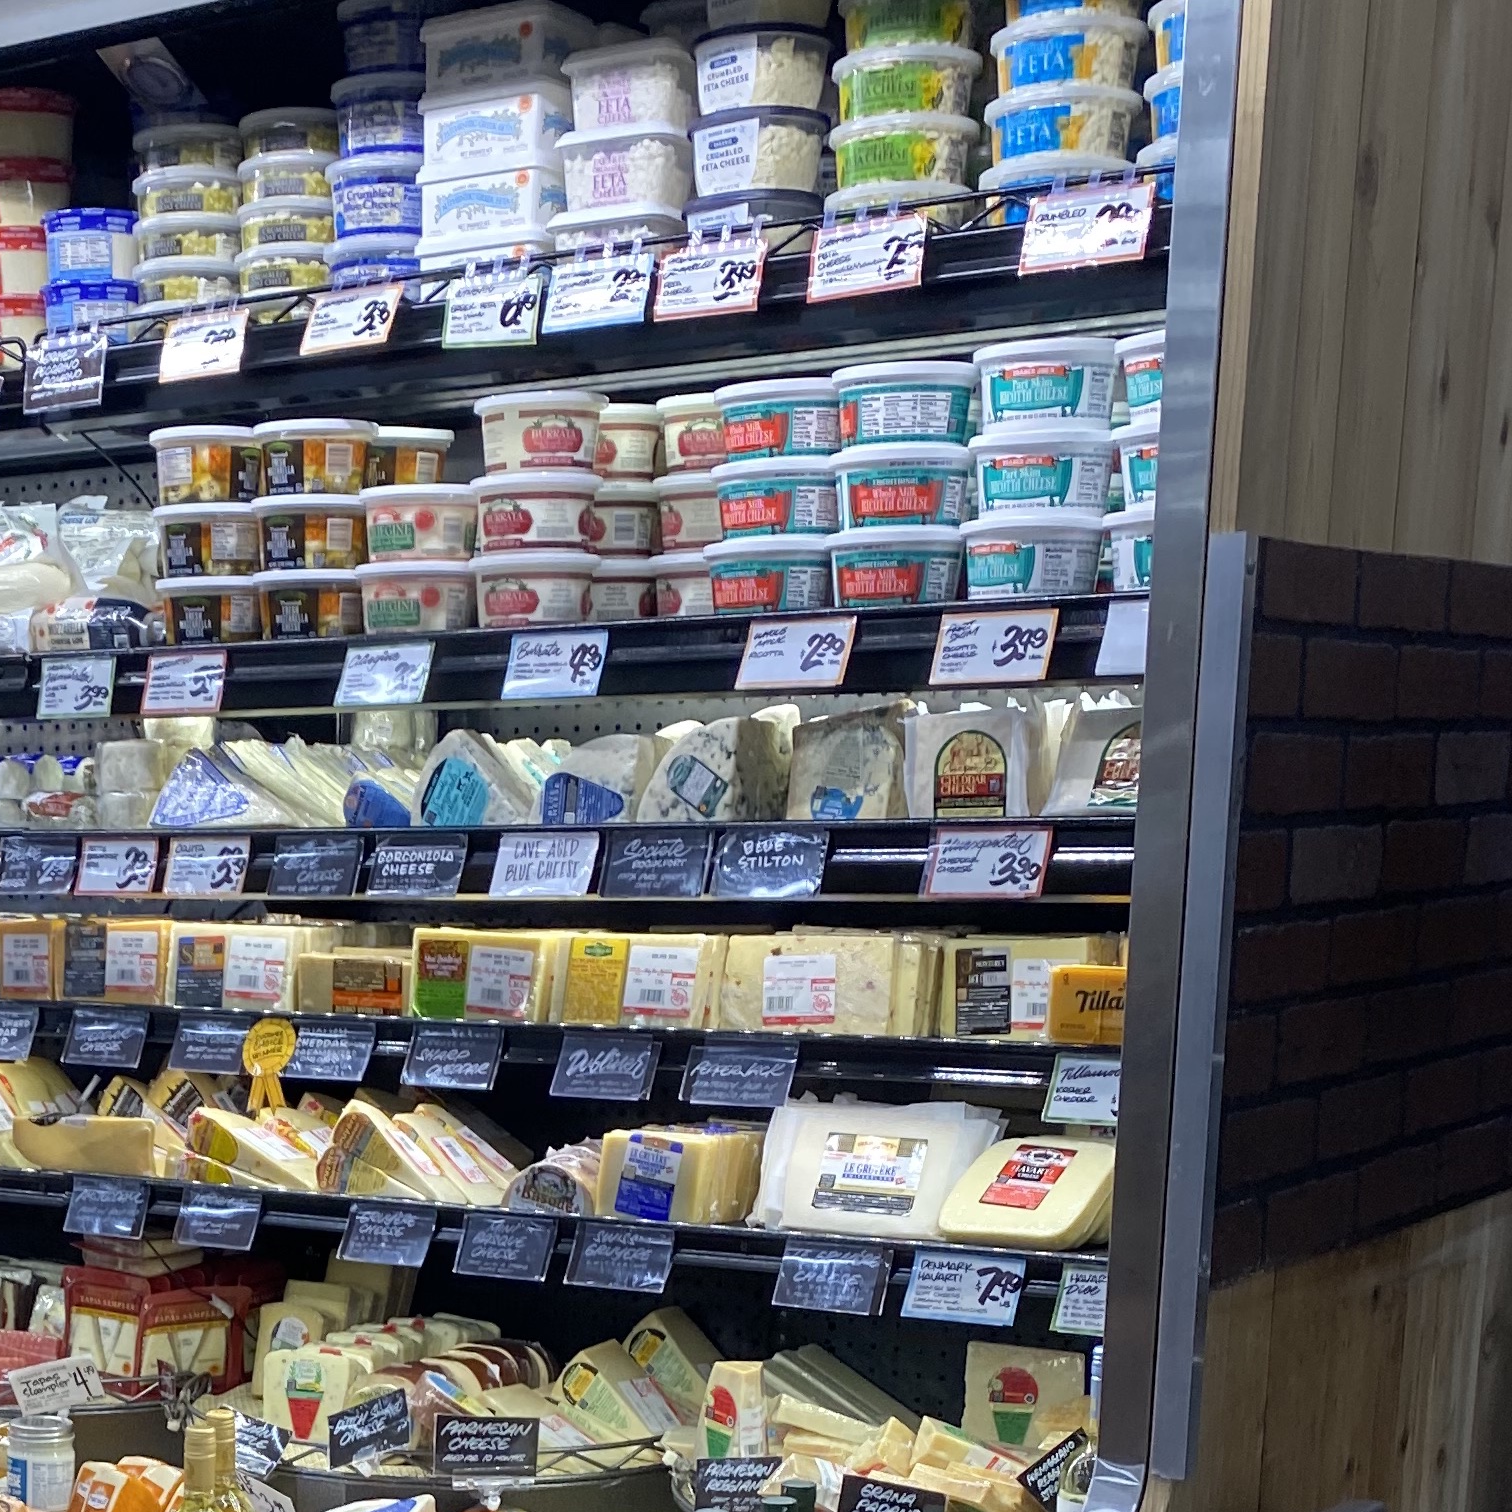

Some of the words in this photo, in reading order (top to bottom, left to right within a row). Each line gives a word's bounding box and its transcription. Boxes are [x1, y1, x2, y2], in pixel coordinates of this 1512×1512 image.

[1018, 52, 1065, 76] FETA
[598, 98, 631, 114] FETA
[1008, 124, 1051, 146] FETA
[593, 174, 626, 188] FETA
[346, 186, 396, 199] Crumbled
[1012, 379, 1029, 392] Part
[1031, 377, 1053, 389] Skim
[1034, 386, 1068, 402] CHEESE
[1002, 469, 1018, 480] Part
[1020, 467, 1041, 479] Skim
[1022, 476, 1057, 492] CHEESE
[377, 849, 454, 864] GORGONZOLA
[513, 840, 543, 859] CAVE
[547, 839, 579, 858] AGED
[738, 854, 804, 870] STILTON
[381, 863, 435, 877] CHEESE
[505, 862, 532, 882] BLUE
[537, 860, 579, 881] CHEESE
[415, 1048, 470, 1062] SHARP
[843, 1161, 855, 1174] LE
[920, 1259, 976, 1271] DENMARK
[917, 1271, 963, 1284] HAVARTI
[21, 1371, 61, 1388] Tapas
[440, 1419, 532, 1438] PARMESAN
[448, 1436, 512, 1451] CHEESE
[704, 1462, 774, 1478] PARMESAN
[705, 1479, 766, 1494] REGGIAN
[859, 1483, 917, 1506] GRANA
